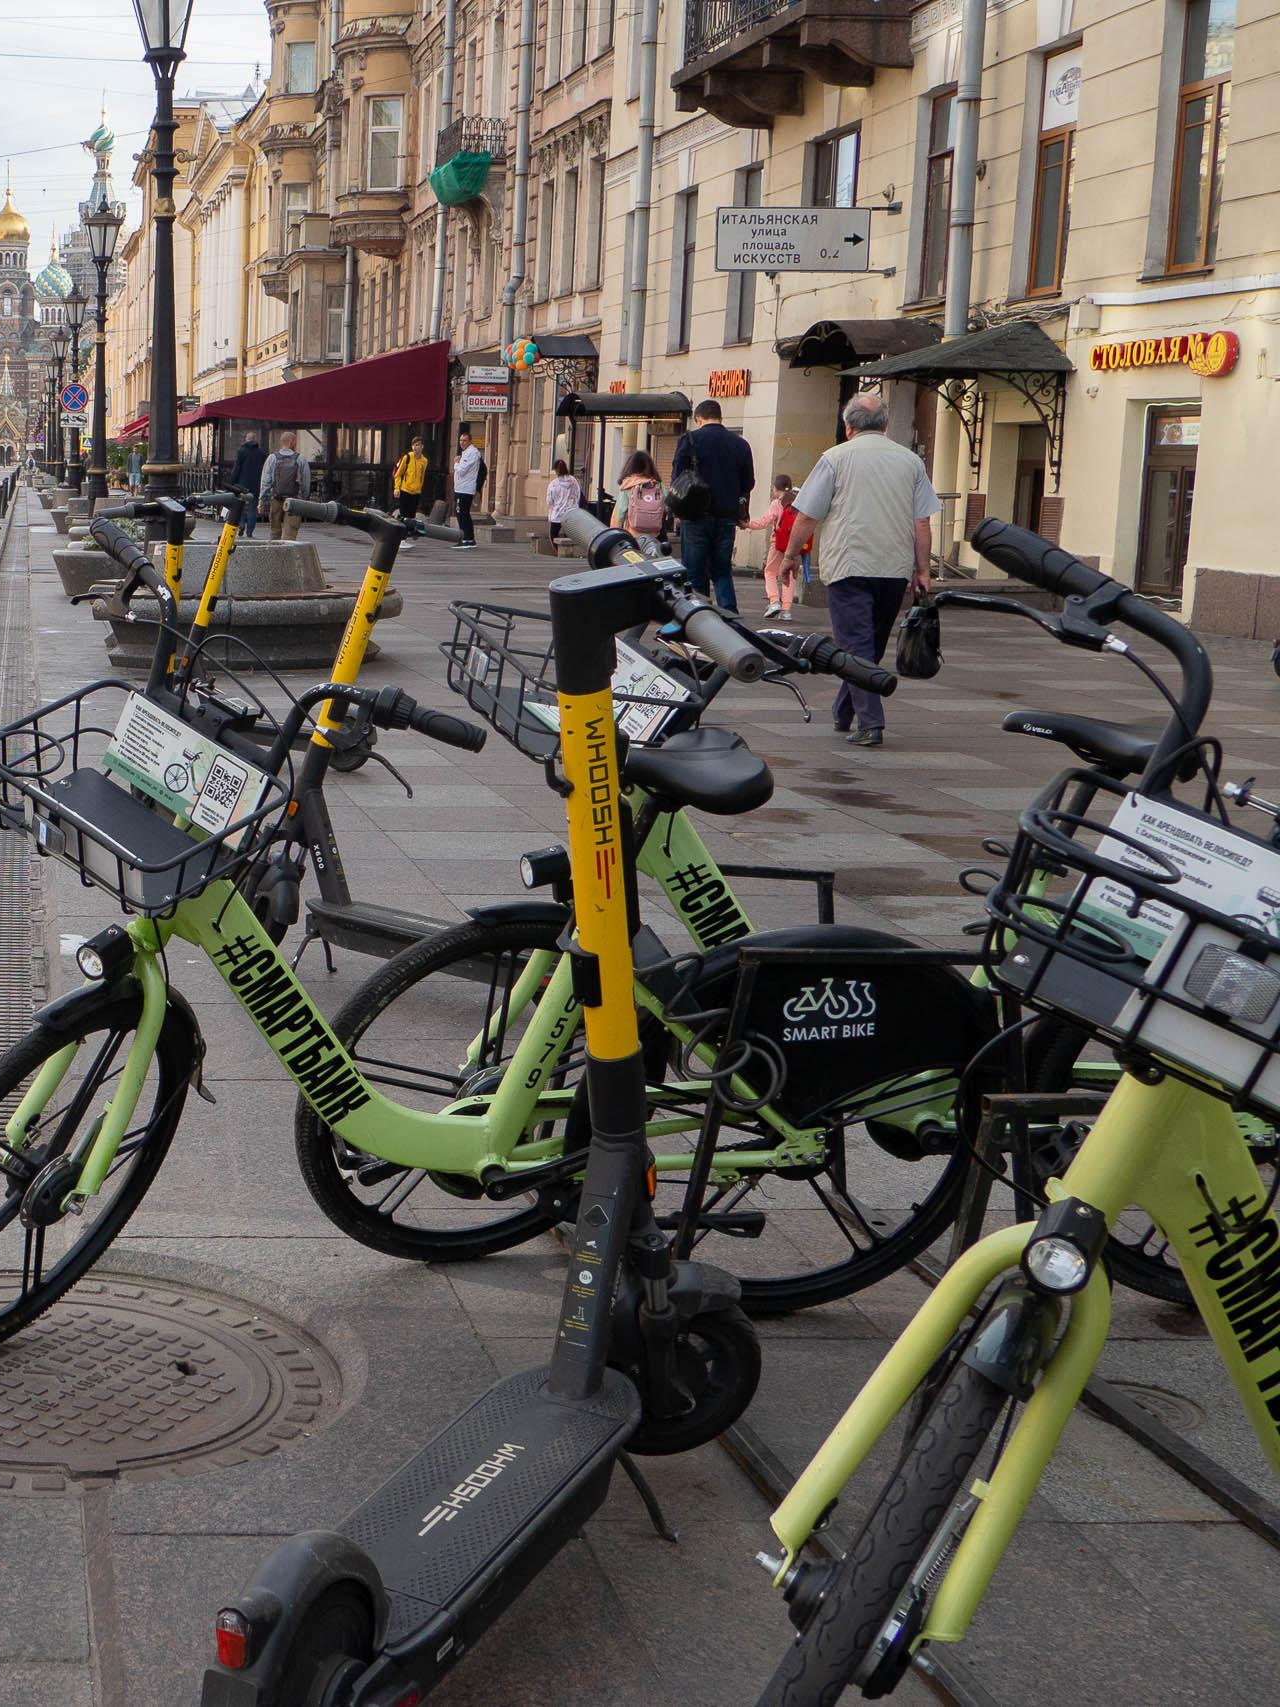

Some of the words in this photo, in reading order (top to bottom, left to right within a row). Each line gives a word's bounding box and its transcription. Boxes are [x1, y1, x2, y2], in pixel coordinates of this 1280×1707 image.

[722, 214, 818, 225] ИТАЛЬЯНСКАЯ
[751, 227, 787, 238] улица
[742, 240, 795, 251] площадь
[733, 253, 801, 264] ИСКУССТВ
[1089, 335, 1182, 370] СТОЛОВАЯ
[707, 369, 748, 398] СУВЕНИРЫ
[468, 397, 506, 407] ВОЕНМАГ
[1031, 726, 1053, 735] VELO
[585, 716, 614, 846] WHOOSH
[1140, 812, 1157, 825] КАК
[1156, 819, 1204, 846] АРЕНДОВАТЬ
[1202, 840, 1252, 868] ВЕЛОСИПЕД?
[313, 844, 325, 869] X600
[213, 934, 372, 1126] #СМАРТБАЙК
[783, 1025, 838, 1041] SMART
[842, 1022, 875, 1038] BIKE
[442, 1443, 525, 1509] WHOOSH
